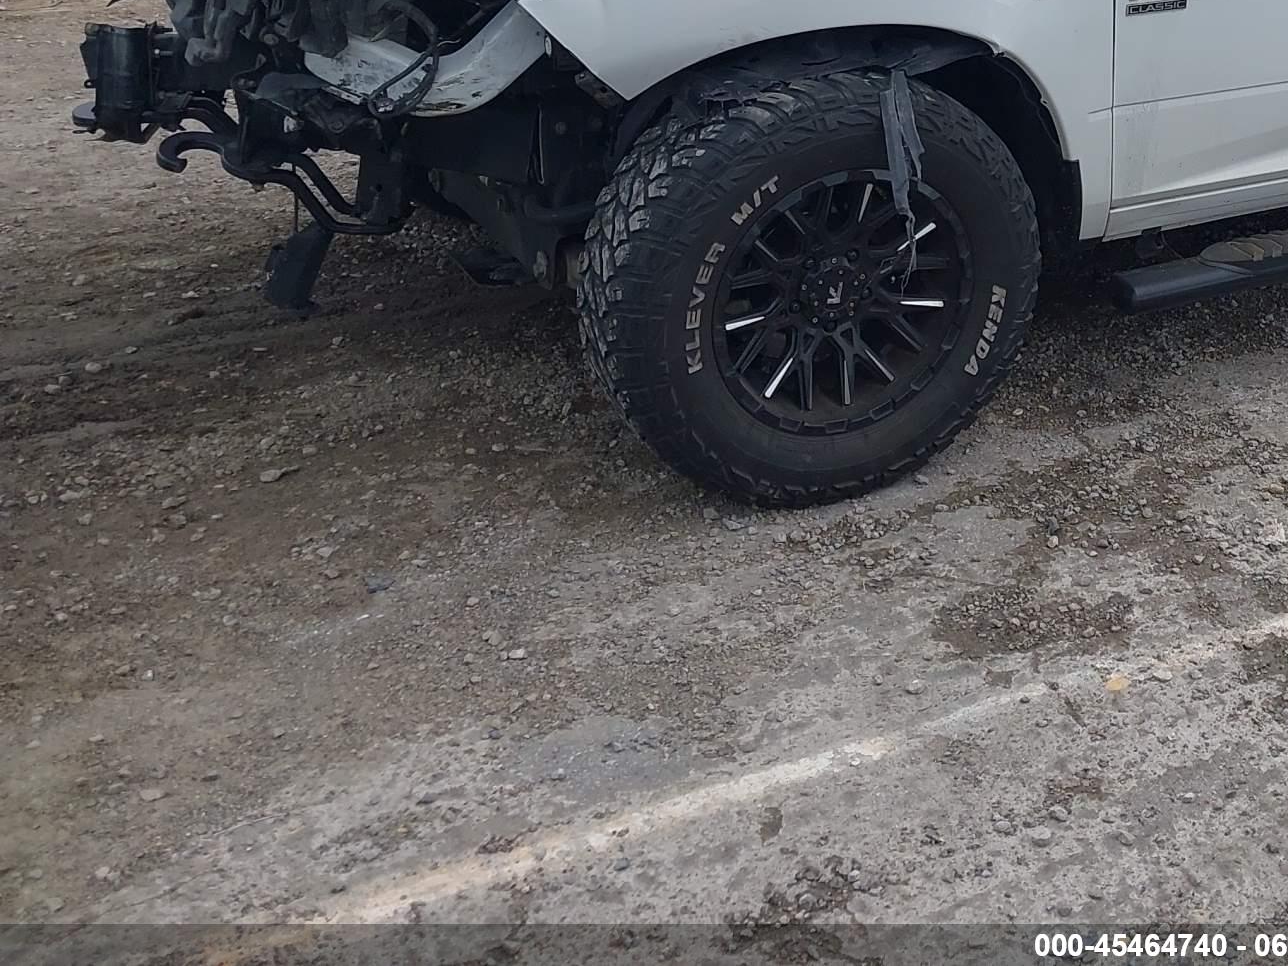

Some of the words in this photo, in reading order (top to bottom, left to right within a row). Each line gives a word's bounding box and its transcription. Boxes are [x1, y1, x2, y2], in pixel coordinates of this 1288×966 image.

[1129, 0, 1186, 14] CLASSIC
[685, 242, 726, 375] KLEVER
[731, 175, 779, 225] M/T
[964, 284, 1007, 376] KENDA
